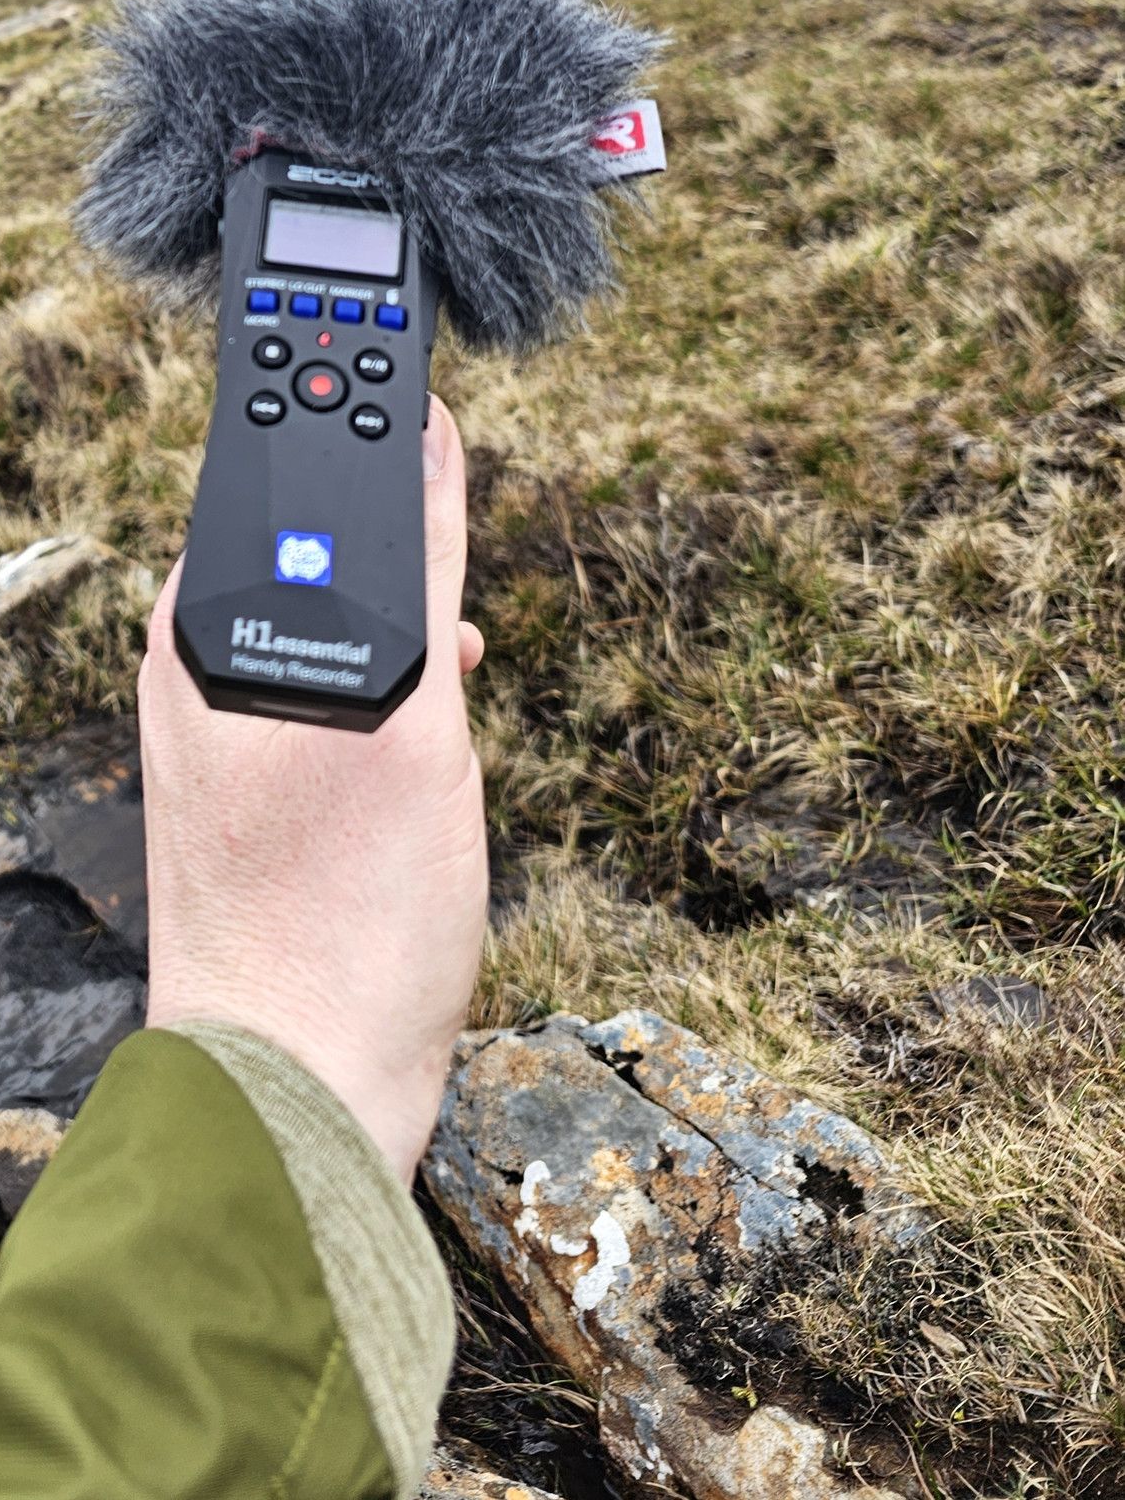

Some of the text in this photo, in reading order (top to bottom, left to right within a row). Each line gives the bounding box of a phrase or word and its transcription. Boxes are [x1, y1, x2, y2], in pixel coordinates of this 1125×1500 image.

[329, 285, 375, 301] MARKER
[243, 314, 281, 328] MONO
[230, 651, 367, 689] Handy Recorder
